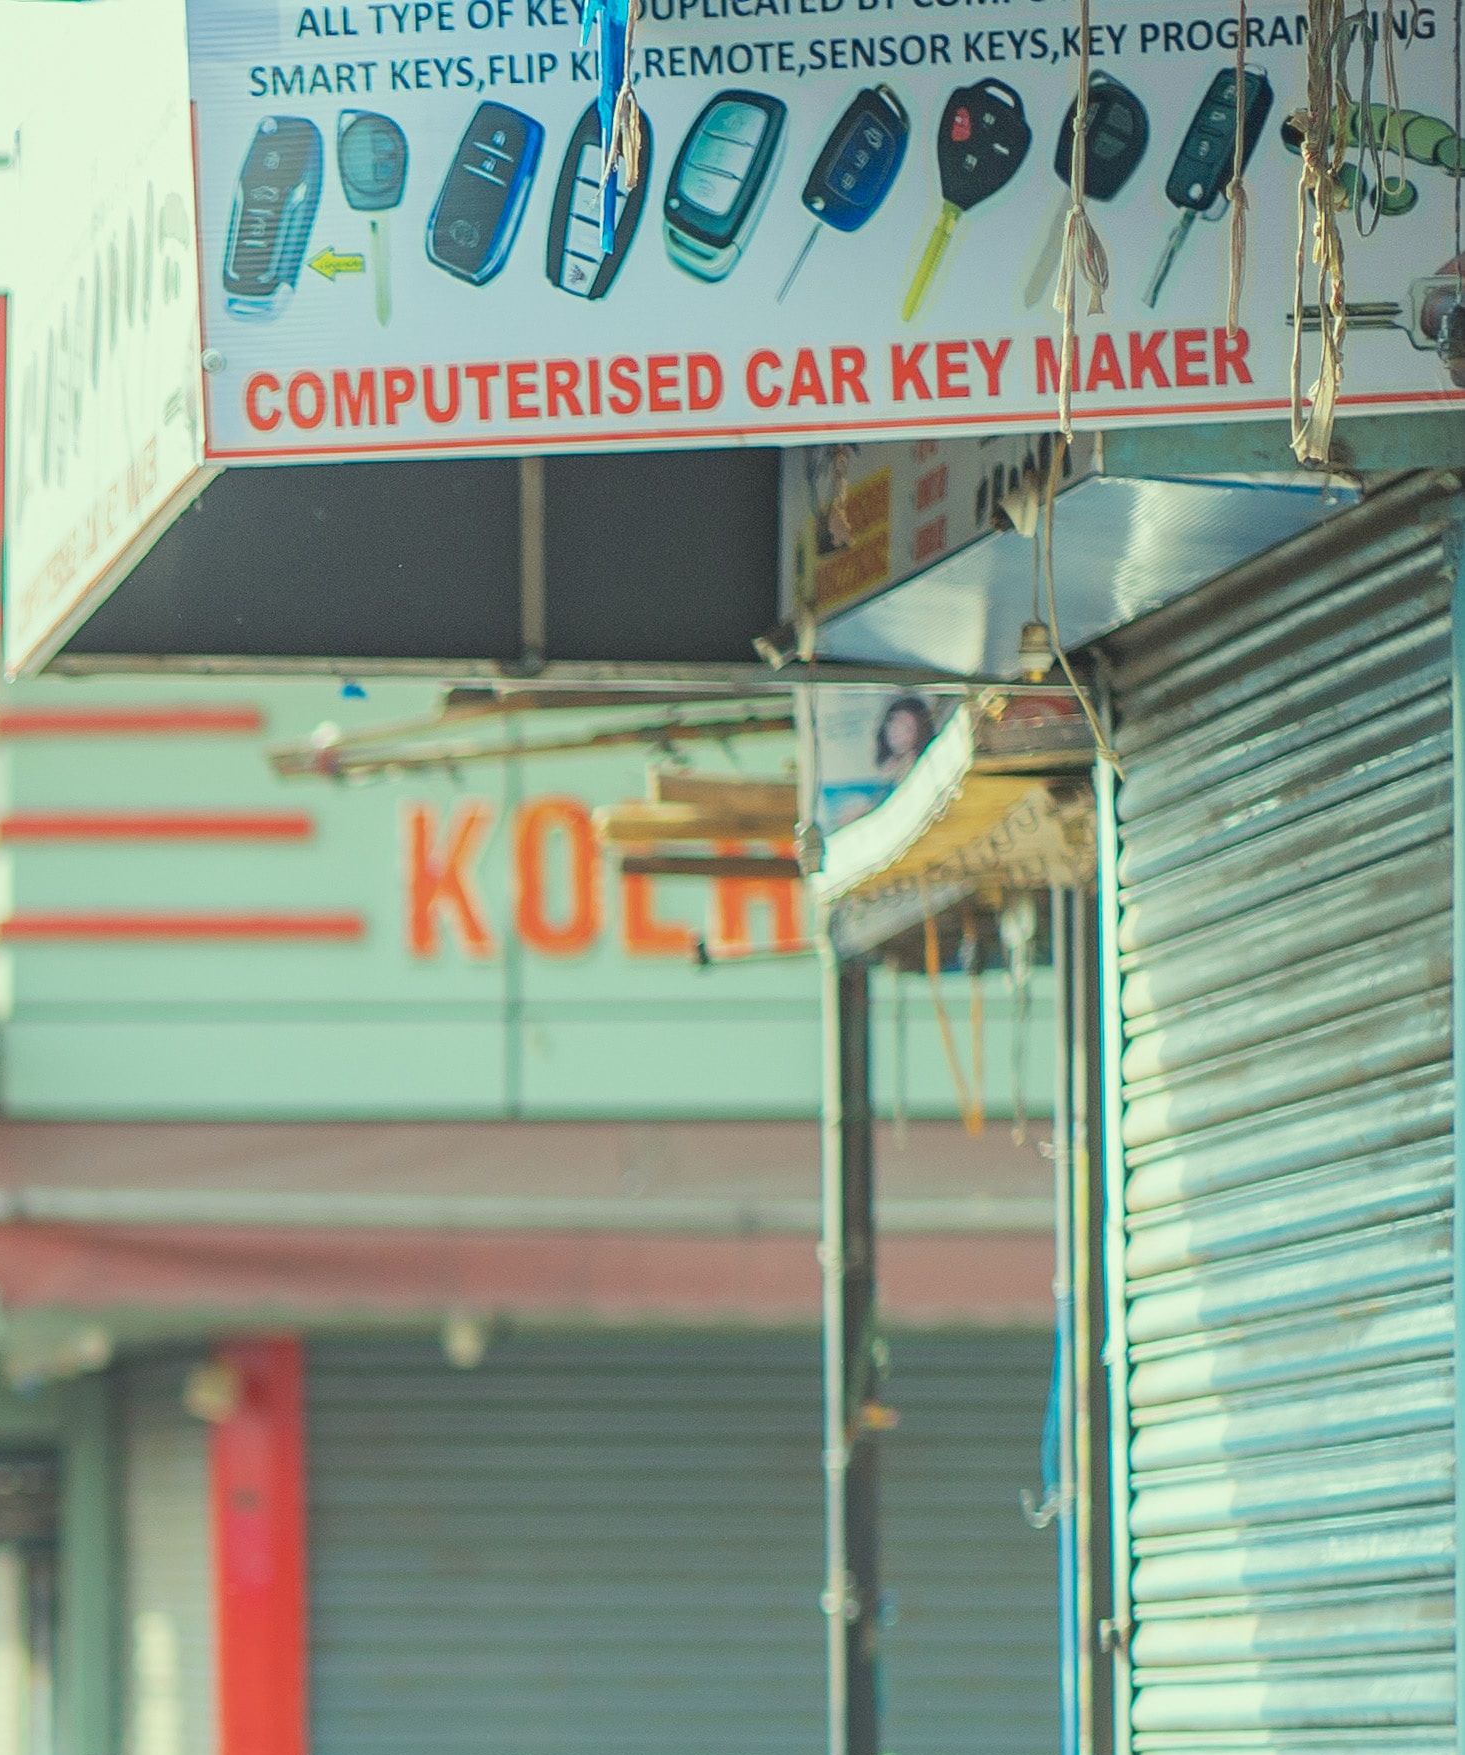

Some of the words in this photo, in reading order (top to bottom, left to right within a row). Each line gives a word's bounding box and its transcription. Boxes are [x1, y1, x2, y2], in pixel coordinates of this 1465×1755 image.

[296, 7, 358, 37] ALL
[368, 2, 454, 34] TYPE
[467, 0, 513, 30] OF
[249, 60, 377, 97] SMART
[245, 352, 723, 431] COMPUTERISED
[746, 347, 870, 408] CAR
[892, 337, 1010, 400] KEY
[1035, 327, 1254, 396] MAKER
